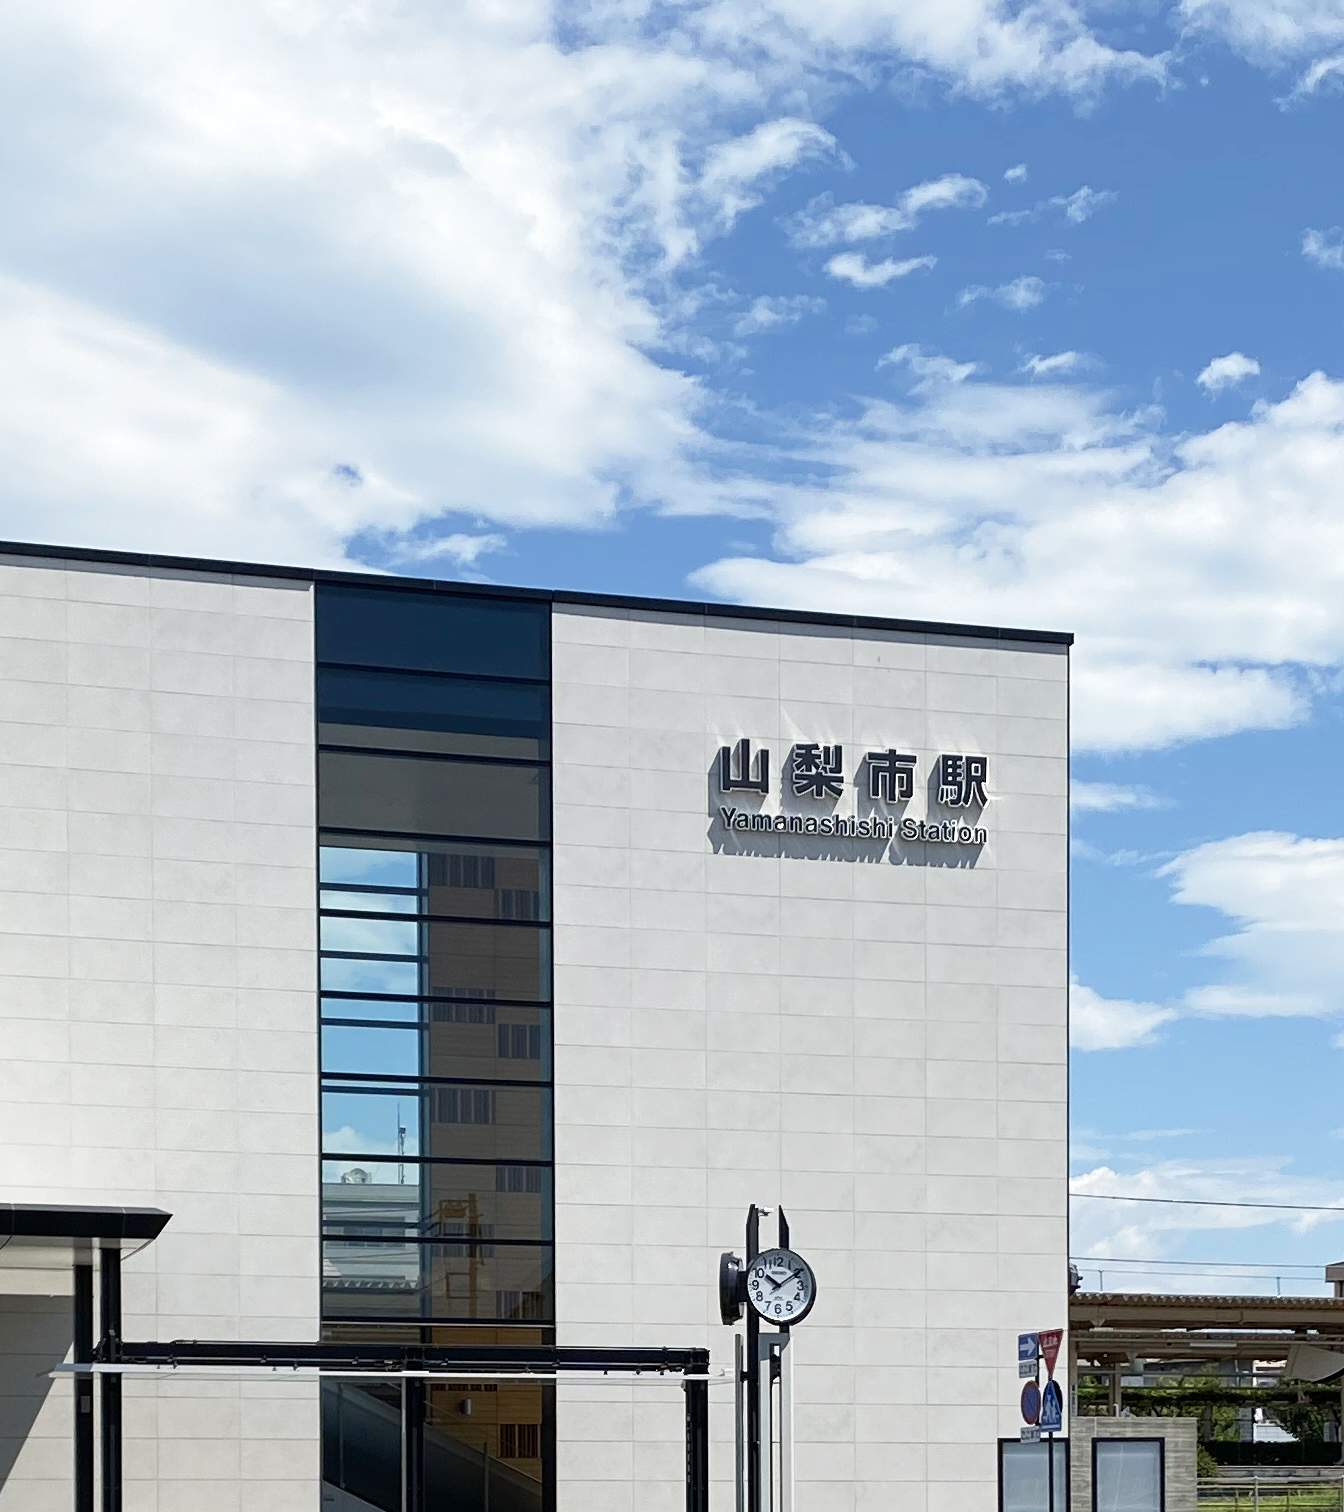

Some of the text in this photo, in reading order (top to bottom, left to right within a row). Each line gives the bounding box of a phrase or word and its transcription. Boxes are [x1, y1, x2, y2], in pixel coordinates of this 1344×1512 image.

[720, 737, 990, 807] 山梨市駅
[720, 806, 988, 844] Yamanashishi Station
[773, 1256, 784, 1268] 12
[752, 1267, 765, 1279] 10
[751, 1279, 760, 1291] 9
[796, 1280, 805, 1291] 3
[755, 1290, 764, 1302] 8
[793, 1292, 801, 1301] 4
[764, 1300, 773, 1311] 7
[774, 1303, 782, 1315] 6
[785, 1301, 794, 1312] 5
